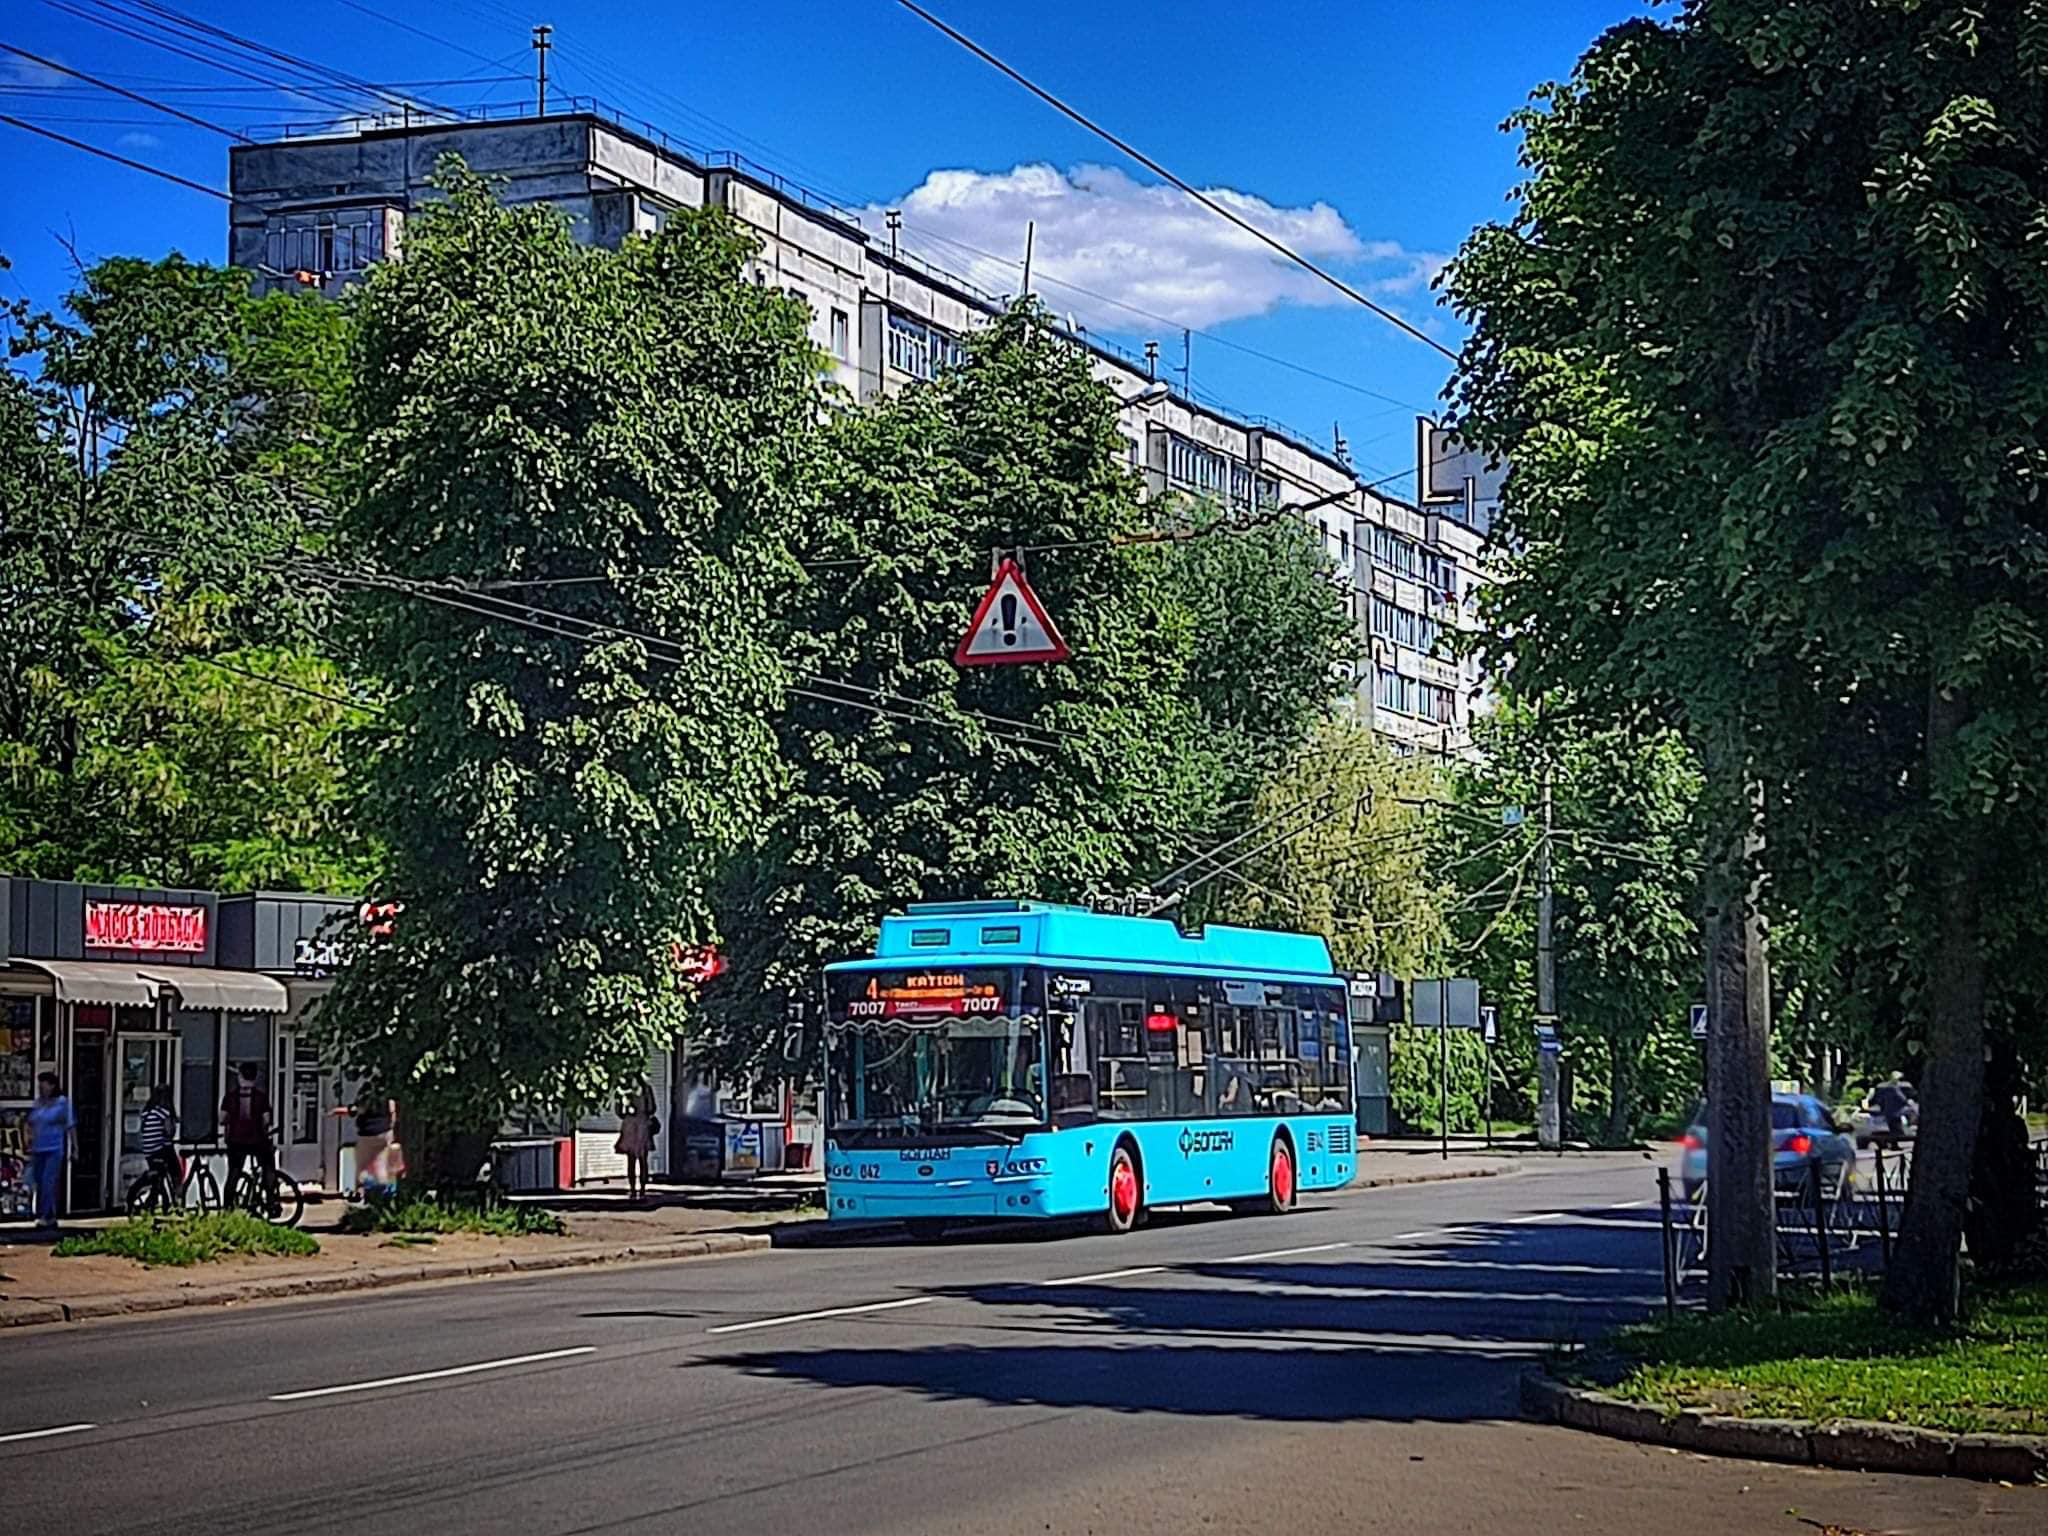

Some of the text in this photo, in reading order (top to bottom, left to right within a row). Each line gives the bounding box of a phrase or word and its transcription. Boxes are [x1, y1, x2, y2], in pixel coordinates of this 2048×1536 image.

[866, 977, 878, 999] 4
[850, 1001, 886, 1015] 7007
[961, 997, 1000, 1012] 7007
